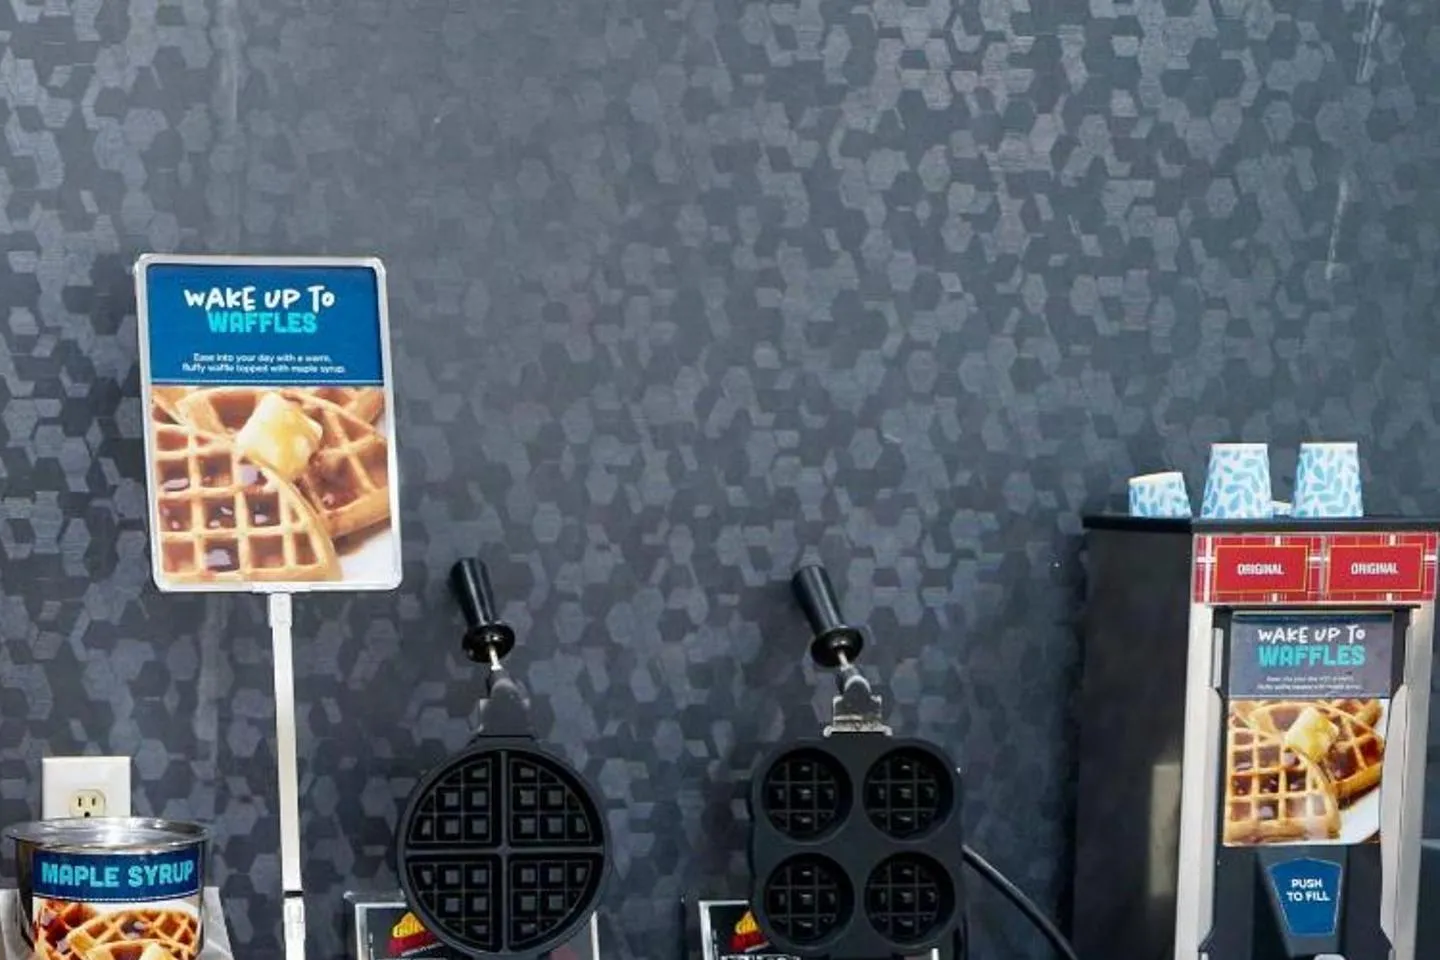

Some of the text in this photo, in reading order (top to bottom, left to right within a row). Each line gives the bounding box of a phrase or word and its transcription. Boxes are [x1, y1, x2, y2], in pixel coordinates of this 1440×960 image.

[184, 285, 335, 312] WAKE UP TO
[208, 311, 318, 334] WAFFLES
[236, 354, 256, 364] your
[257, 353, 275, 364] day
[276, 353, 296, 362] with
[208, 363, 235, 373] waffle
[236, 363, 269, 374] topped
[270, 363, 290, 373] with
[291, 364, 318, 374] maple
[1237, 563, 1285, 575] ORIGINAL
[1351, 562, 1398, 575] ORIGINAL
[1258, 624, 1366, 644] WAKE UP TO
[1259, 644, 1366, 667] WAFFLES
[41, 860, 194, 888] MAPLE SYRUP
[1291, 878, 1323, 889] PUSH
[1286, 890, 1331, 902] TO FILL
